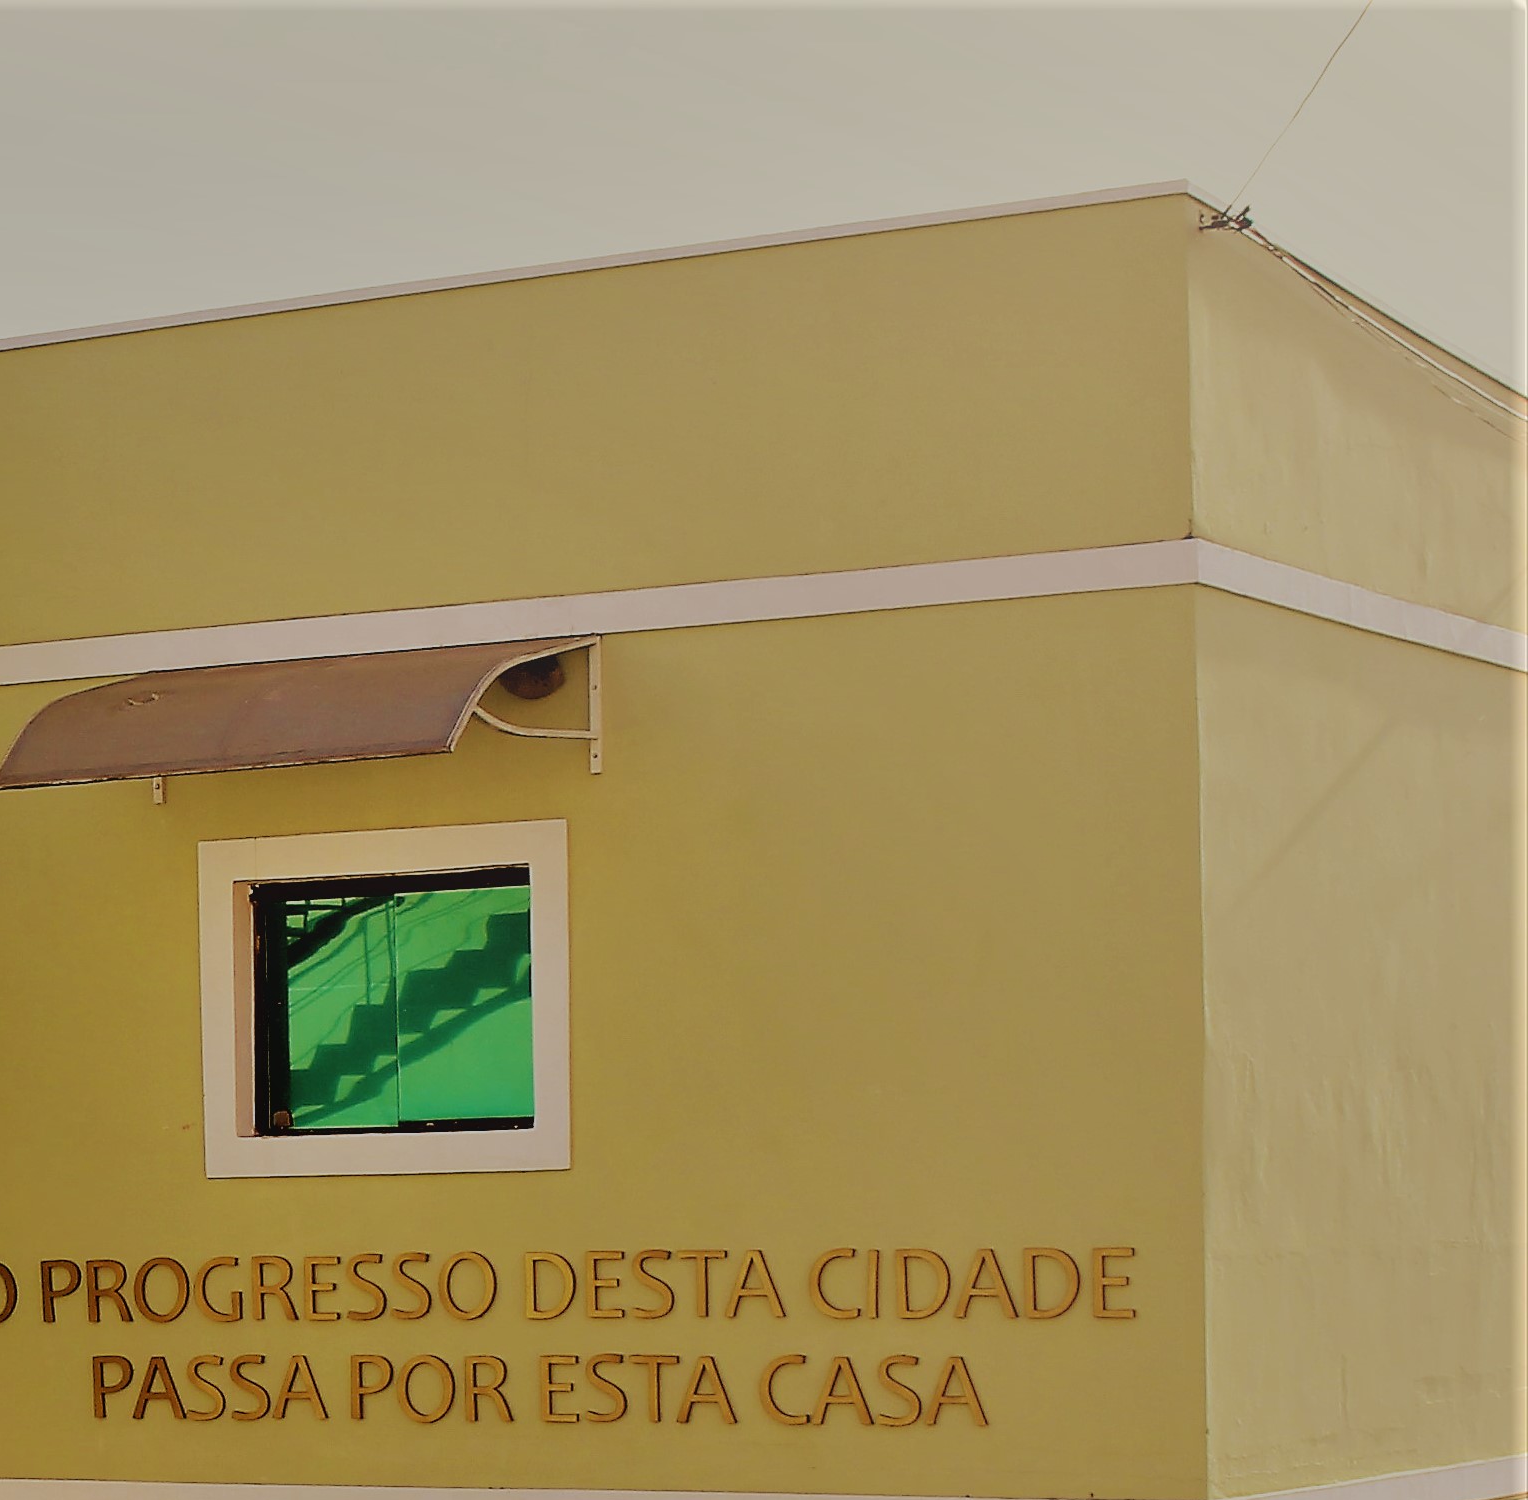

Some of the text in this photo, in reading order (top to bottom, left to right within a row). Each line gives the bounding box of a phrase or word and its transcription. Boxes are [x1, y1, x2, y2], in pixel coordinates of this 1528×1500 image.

[40, 1251, 497, 1324] PROGRESSO
[525, 1249, 786, 1320] DESTA
[809, 1247, 1136, 1320] CIDADE
[92, 1354, 989, 1426] PASSA POR ESTA CASA
